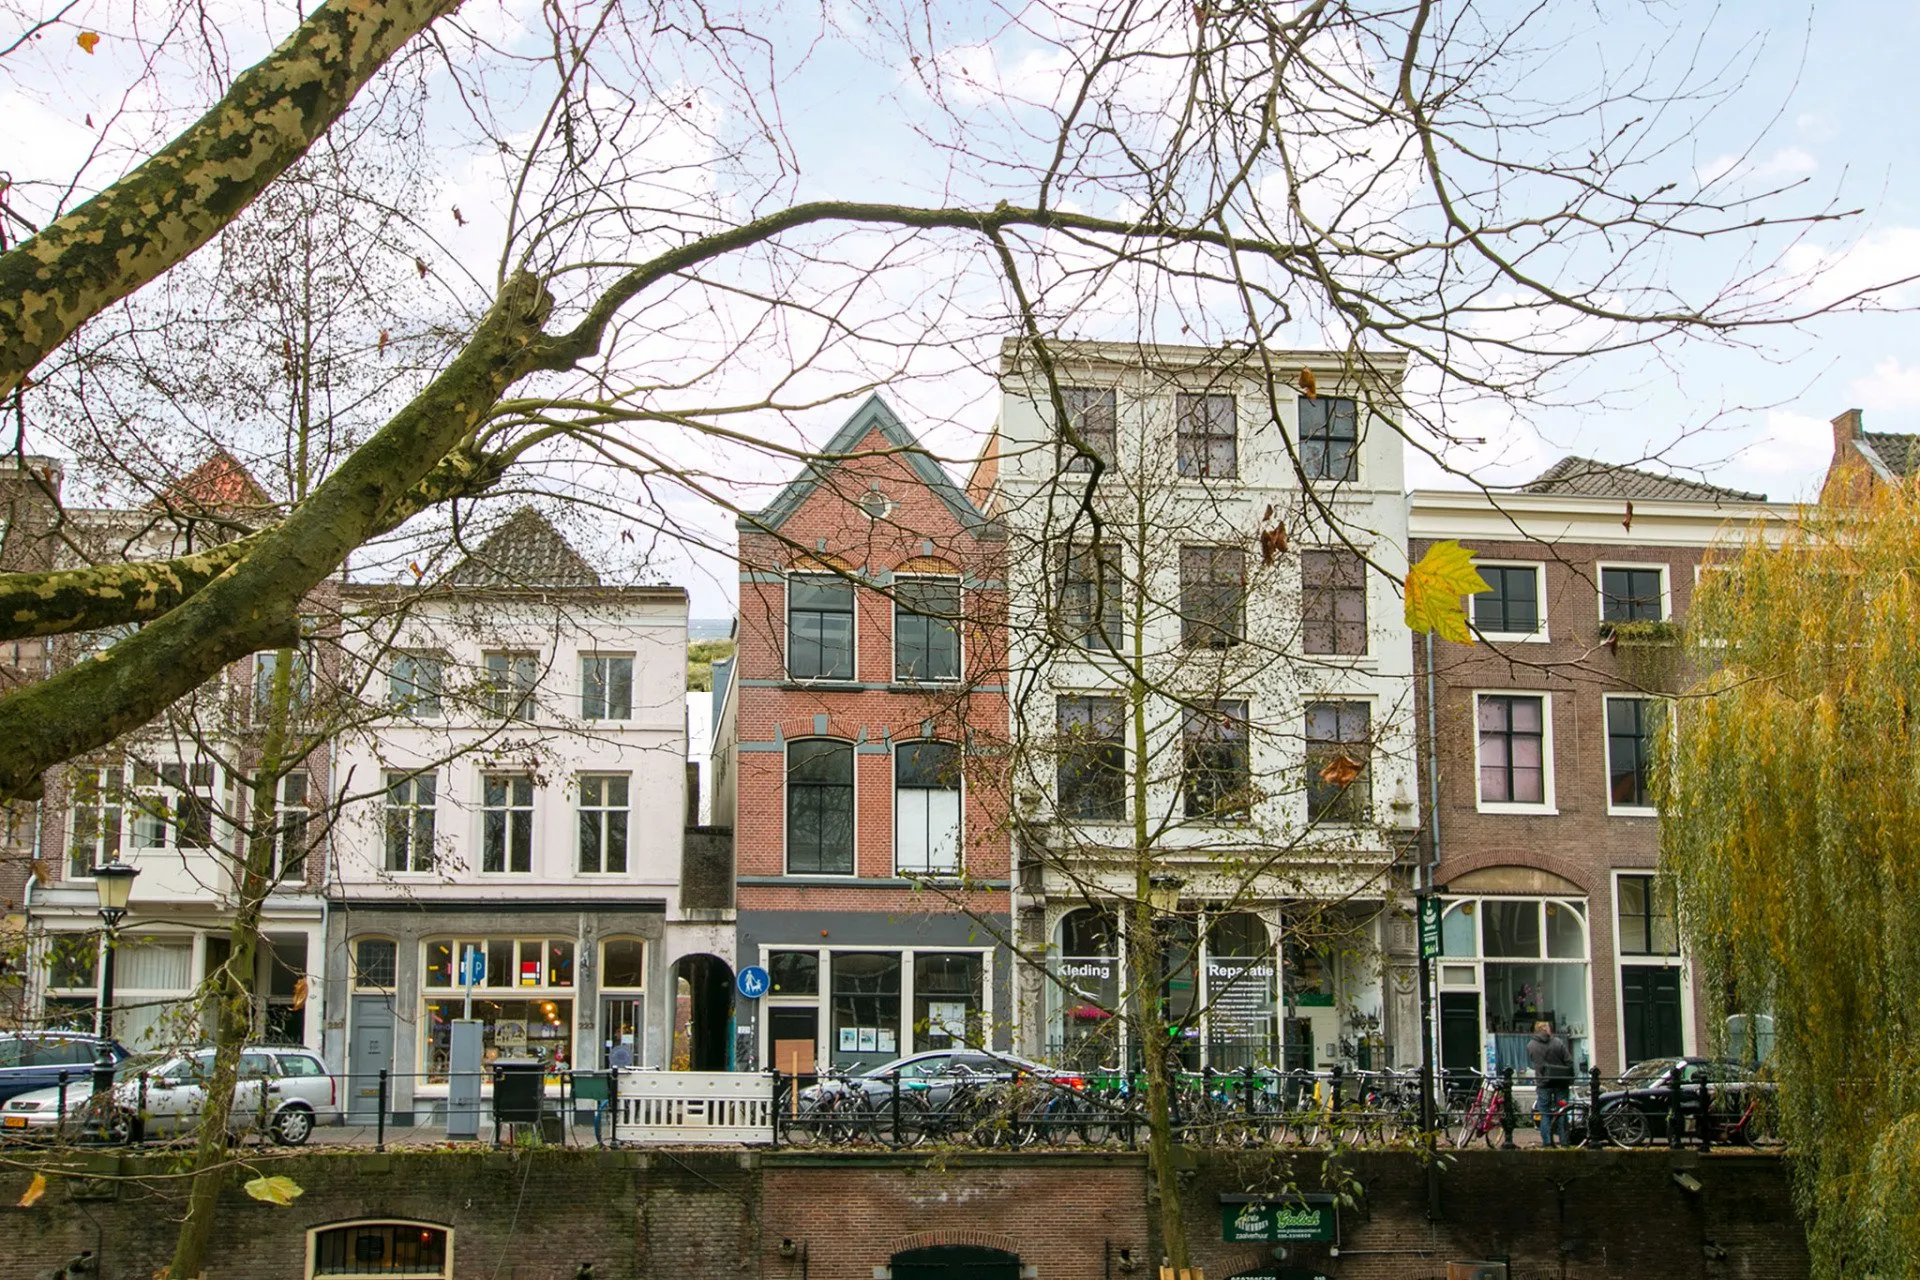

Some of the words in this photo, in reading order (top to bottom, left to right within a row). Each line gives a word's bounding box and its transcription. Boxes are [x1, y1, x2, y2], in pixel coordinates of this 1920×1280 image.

[1057, 964, 1110, 979] Kleding
[1208, 964, 1274, 979] Repaatie
[1276, 1209, 1321, 1229] Grolsch
